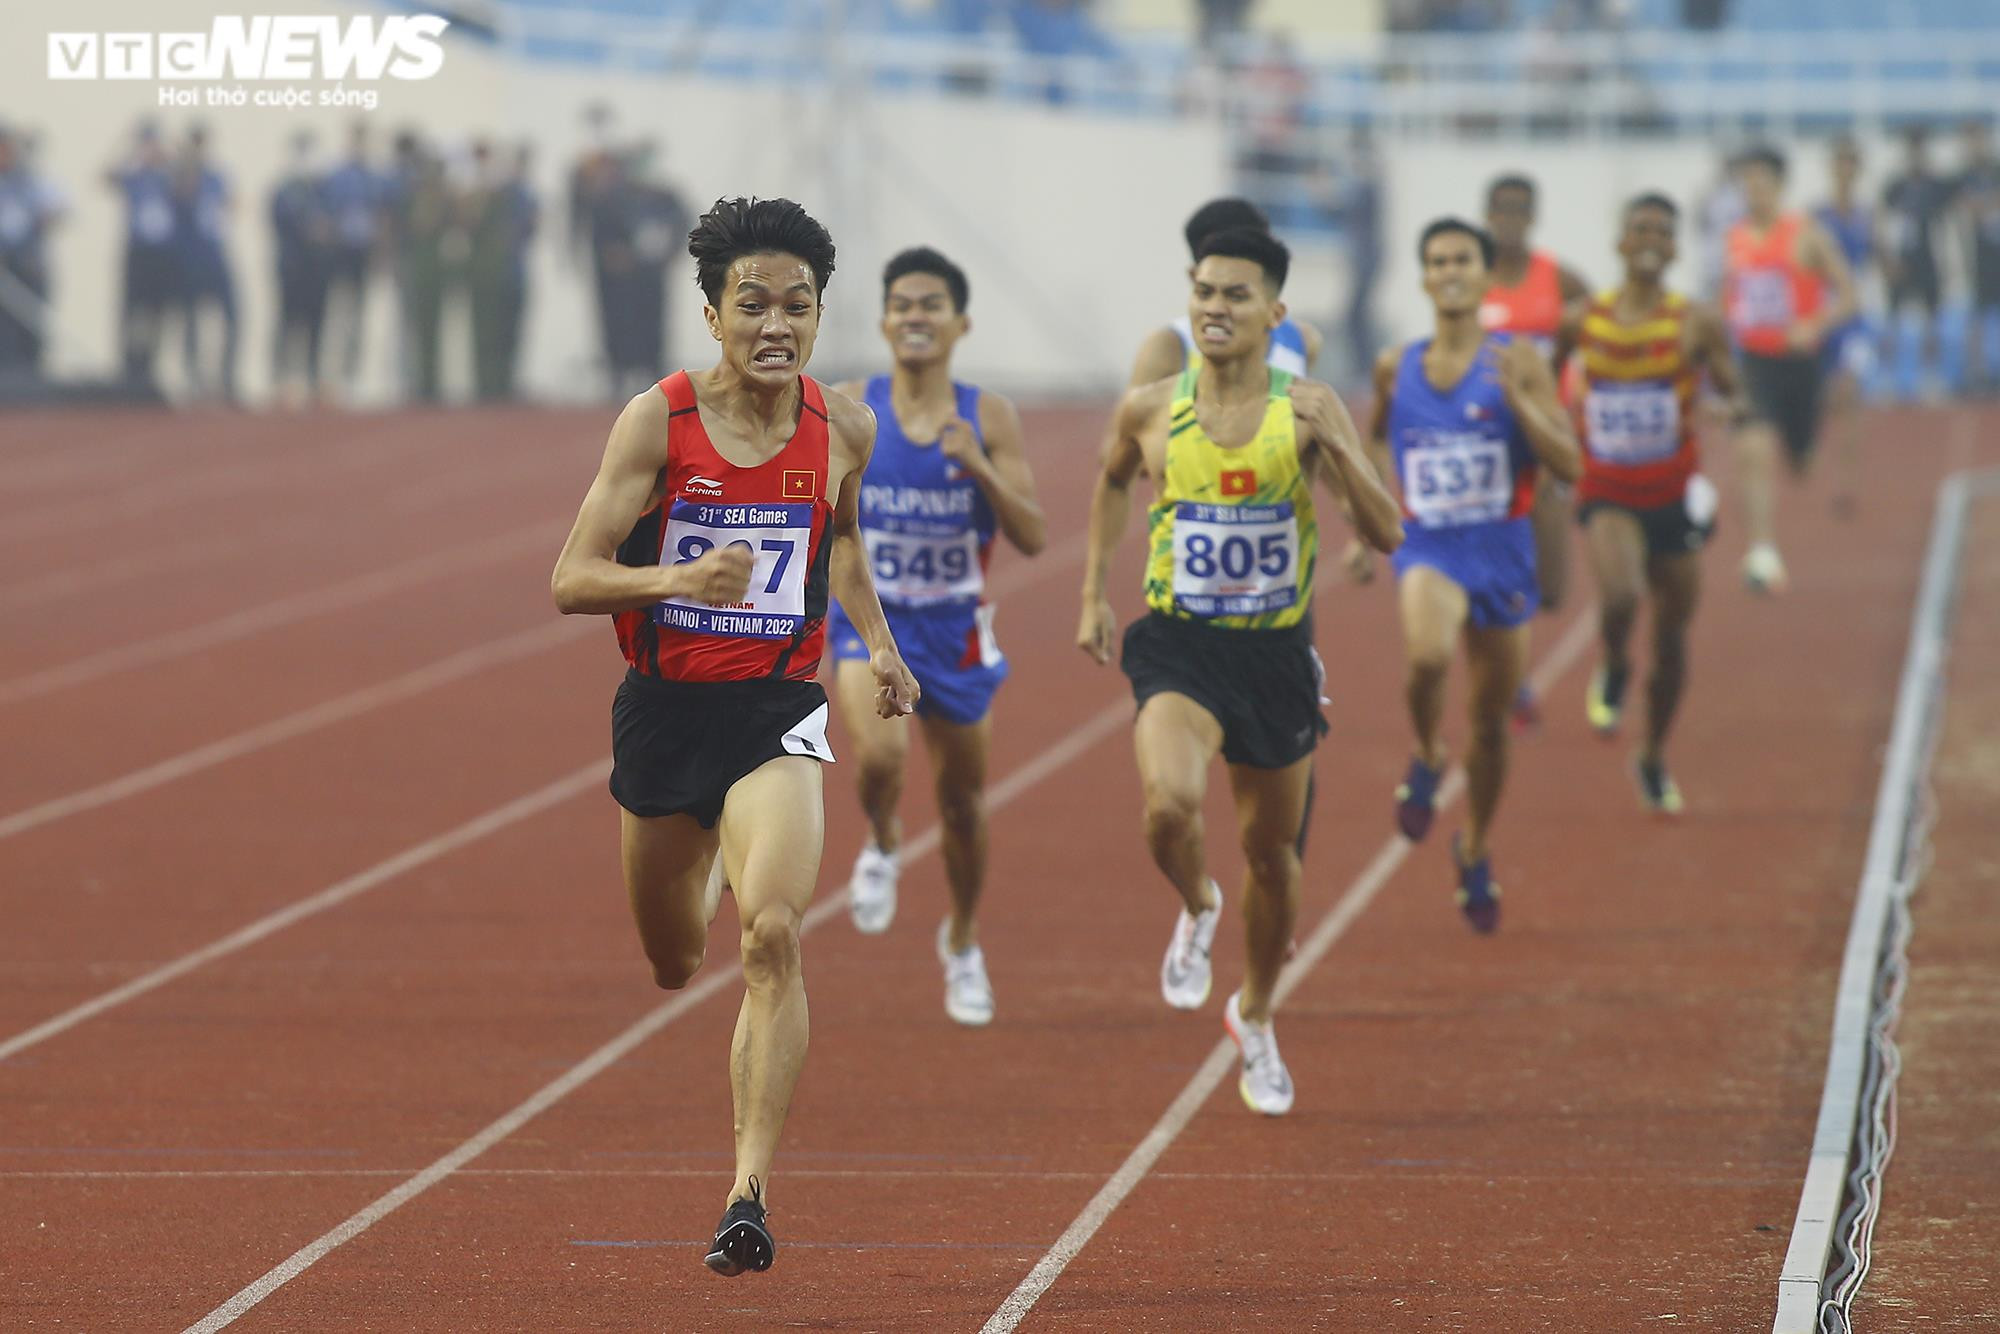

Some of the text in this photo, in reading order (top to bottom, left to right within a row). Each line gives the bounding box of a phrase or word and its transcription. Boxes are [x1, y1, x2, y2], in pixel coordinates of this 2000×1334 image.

[685, 485, 723, 497] LI-NING
[1417, 454, 1496, 495] 537
[723, 508, 745, 524] SEA
[749, 508, 788, 525] Games
[874, 543, 968, 582] 549
[1185, 533, 1290, 579] 805
[663, 608, 700, 629] HANOI
[711, 615, 762, 634] VIETNAM
[765, 619, 794, 635] 2022
